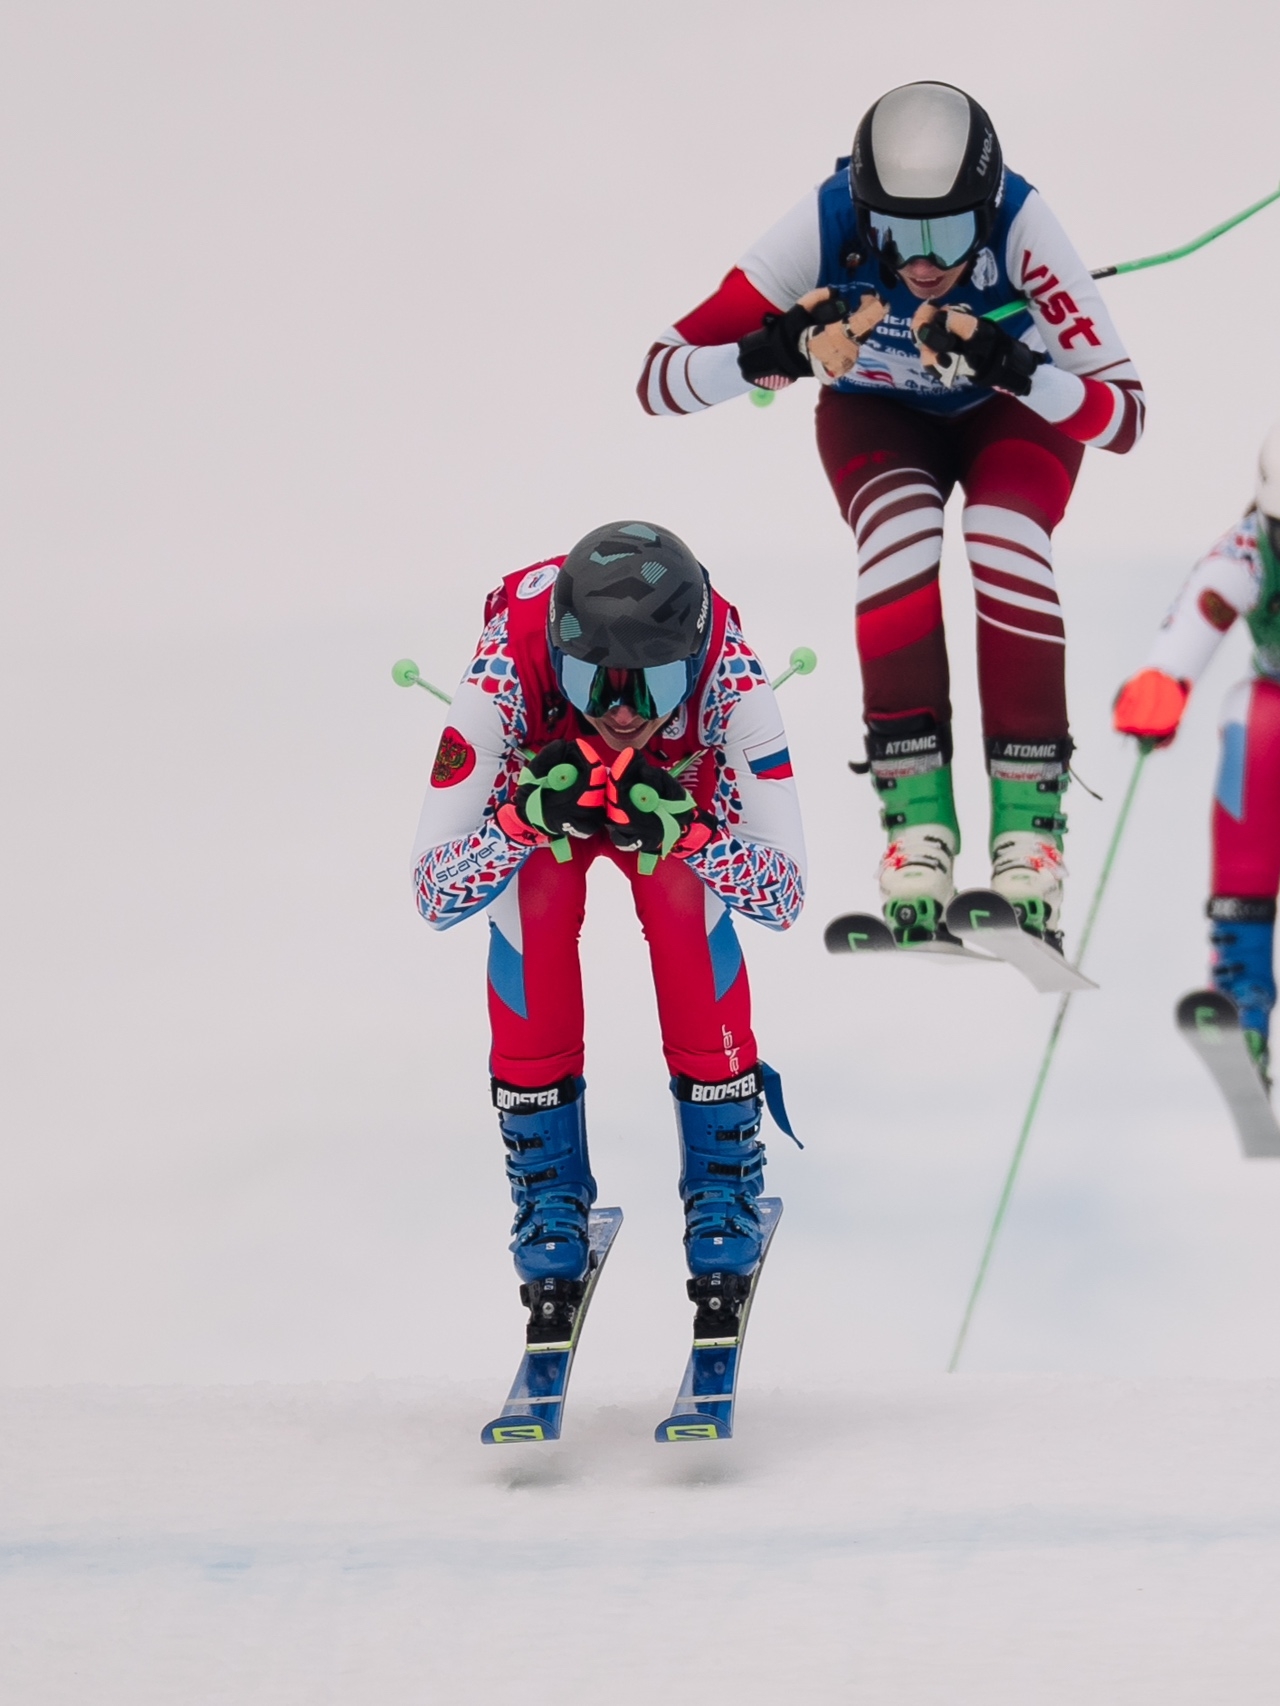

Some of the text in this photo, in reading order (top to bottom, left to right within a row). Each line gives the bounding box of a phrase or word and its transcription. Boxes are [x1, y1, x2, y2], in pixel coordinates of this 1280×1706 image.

[976, 127, 993, 176] uvex
[885, 735, 937, 755] ATOMIC
[1003, 743, 1056, 758] ATOMIC
[436, 841, 498, 883] stayer
[496, 1087, 560, 1110] BOOSTER
[691, 1073, 757, 1102] BOOSTER
